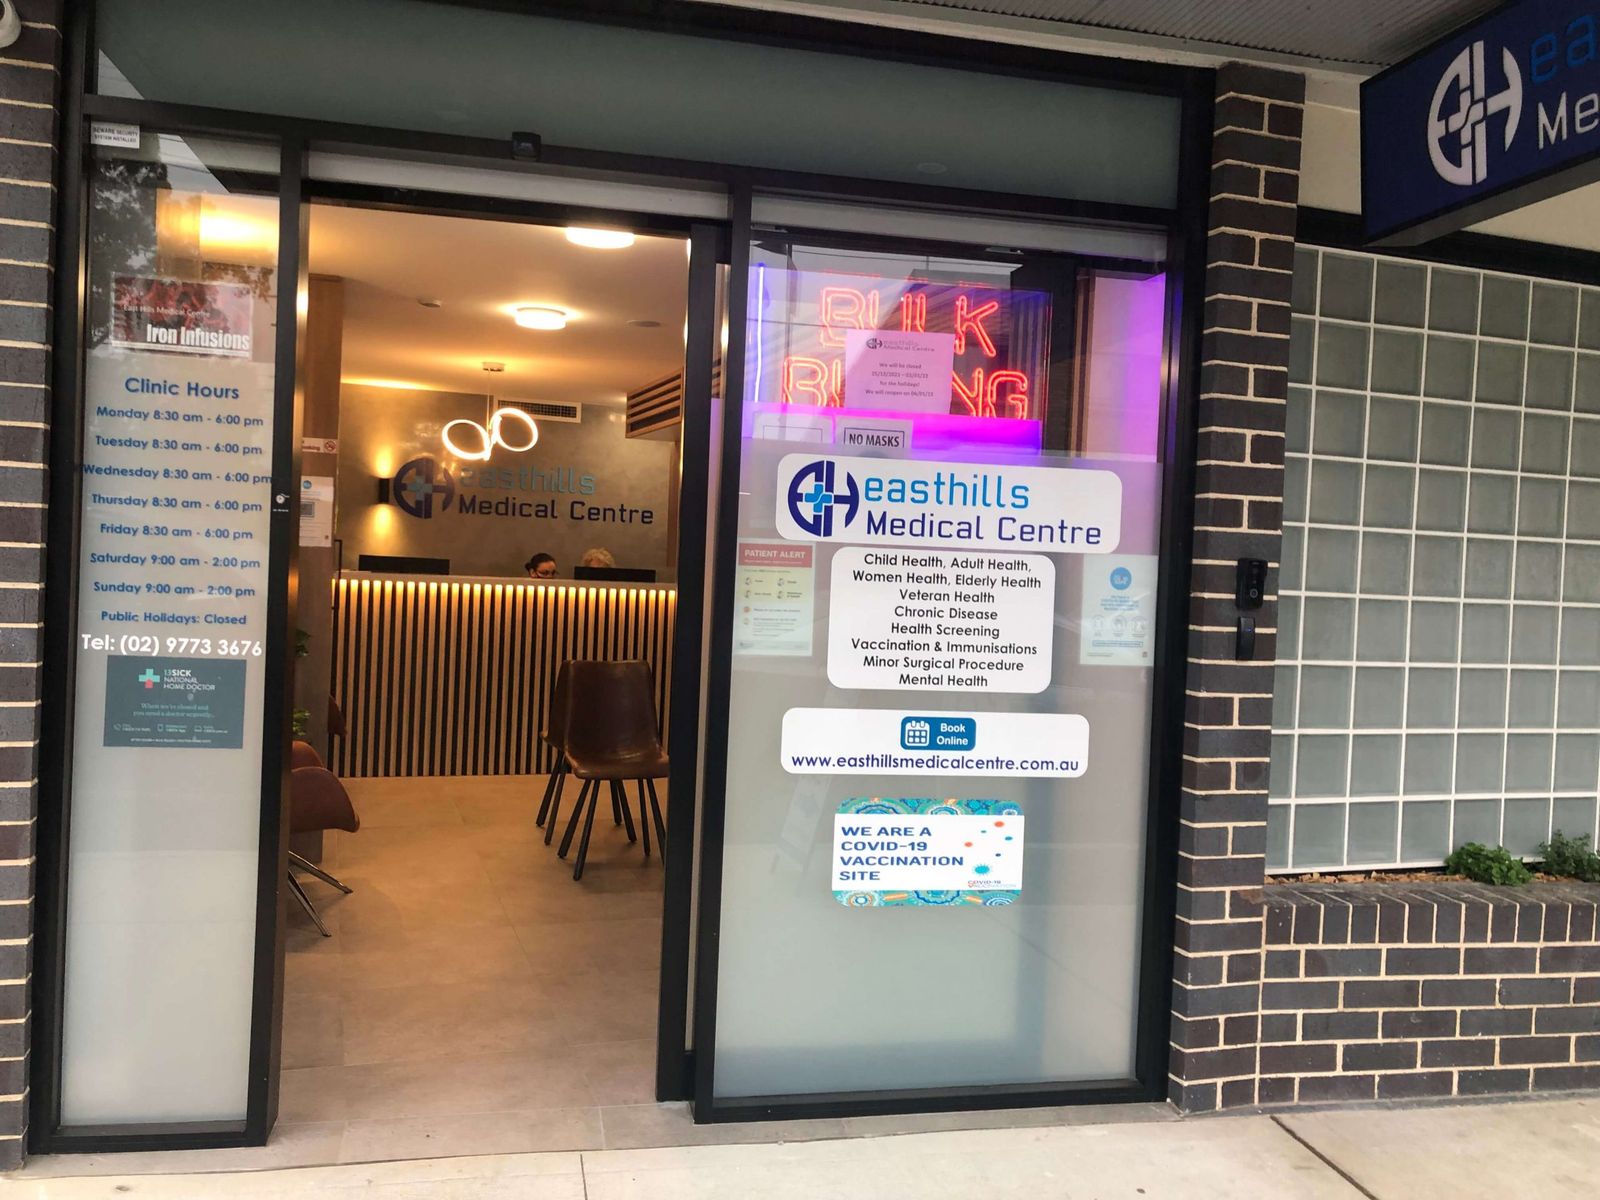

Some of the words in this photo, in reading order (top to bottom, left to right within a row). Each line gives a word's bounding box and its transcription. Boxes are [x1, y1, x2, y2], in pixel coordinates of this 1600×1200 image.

[147, 324, 178, 344] Iron
[180, 326, 250, 350] Infusions
[125, 377, 180, 396] Clinic
[187, 381, 240, 399] Hours
[96, 406, 149, 421] Monday
[153, 410, 179, 421] 8:30
[182, 413, 203, 422] am
[215, 414, 241, 425] 6:00
[243, 418, 264, 428] pm
[95, 435, 149, 450] Tuesday
[152, 439, 178, 450] 8:30
[181, 443, 202, 451] am
[214, 443, 239, 453] 6:00
[242, 447, 262, 456] pm
[849, 433, 863, 446] NO
[865, 435, 900, 447] MASKS
[81, 464, 159, 480] Wednesday
[162, 469, 188, 480] 8:30
[192, 472, 212, 481] am
[224, 472, 249, 483] 6:00
[252, 475, 273, 485] pm
[864, 471, 1030, 510] easthills
[92, 493, 149, 508] Thursday
[152, 497, 177, 508] 8:30
[181, 501, 202, 509] am
[214, 500, 239, 511] 6:00
[242, 503, 262, 513] pm
[459, 494, 558, 520] Medical
[570, 501, 654, 525] Centre
[100, 523, 139, 537] Friday
[142, 526, 168, 536] 8:30
[171, 529, 192, 537] am
[204, 529, 230, 539] 6:00
[233, 532, 253, 541] pm
[867, 510, 984, 541] Medical
[998, 517, 1101, 545] Centre
[90, 553, 146, 567] Saturday
[151, 555, 176, 566] 9:00
[179, 558, 200, 566] am
[212, 557, 238, 568] 2:00
[240, 560, 260, 569] pm
[744, 549, 778, 558] PATIENT
[780, 551, 806, 559] ALERT
[864, 554, 898, 566] Child
[902, 556, 946, 569] Health,
[950, 557, 984, 569] Adult
[988, 559, 1032, 573] Health,
[853, 570, 902, 583] Women
[906, 572, 951, 586] Health,
[955, 575, 997, 589] Elderly
[1001, 576, 1041, 589] Health
[93, 582, 141, 595] Sunday
[145, 584, 171, 594] 9:00
[174, 586, 195, 595] am
[207, 585, 232, 596] 2:00
[235, 588, 255, 598] pm
[899, 589, 950, 602] Veteran
[954, 591, 995, 603] Health
[101, 611, 139, 622] Public
[143, 613, 199, 625] Holidays:
[204, 614, 247, 625] Closed
[894, 605, 945, 618] Chronic
[950, 608, 998, 620] Disease
[891, 623, 932, 635] Health
[936, 624, 1000, 639] Screening
[81, 634, 115, 651] Tel:
[120, 635, 160, 656] (02)
[166, 637, 211, 655] 9773
[217, 639, 262, 657] 3676
[851, 638, 930, 652] Vaccination
[934, 642, 943, 652] &
[947, 641, 1037, 655] Immunisations
[863, 656, 900, 668] Minor
[903, 657, 954, 671] Surgical
[959, 659, 1024, 671] Procedure
[186, 683, 215, 691] DOCTOR
[899, 674, 943, 686] Mental
[948, 675, 988, 687] Health
[940, 723, 966, 733] Book
[936, 735, 969, 746] Online
[791, 754, 1079, 772] www.easthillsmedicalcentre.com.au
[841, 827, 872, 837] WE
[876, 827, 915, 837] ARE
[919, 827, 932, 837] A
[841, 841, 928, 851] COVID-19
[840, 855, 964, 866] VACCINATION
[839, 871, 881, 881] SITE
